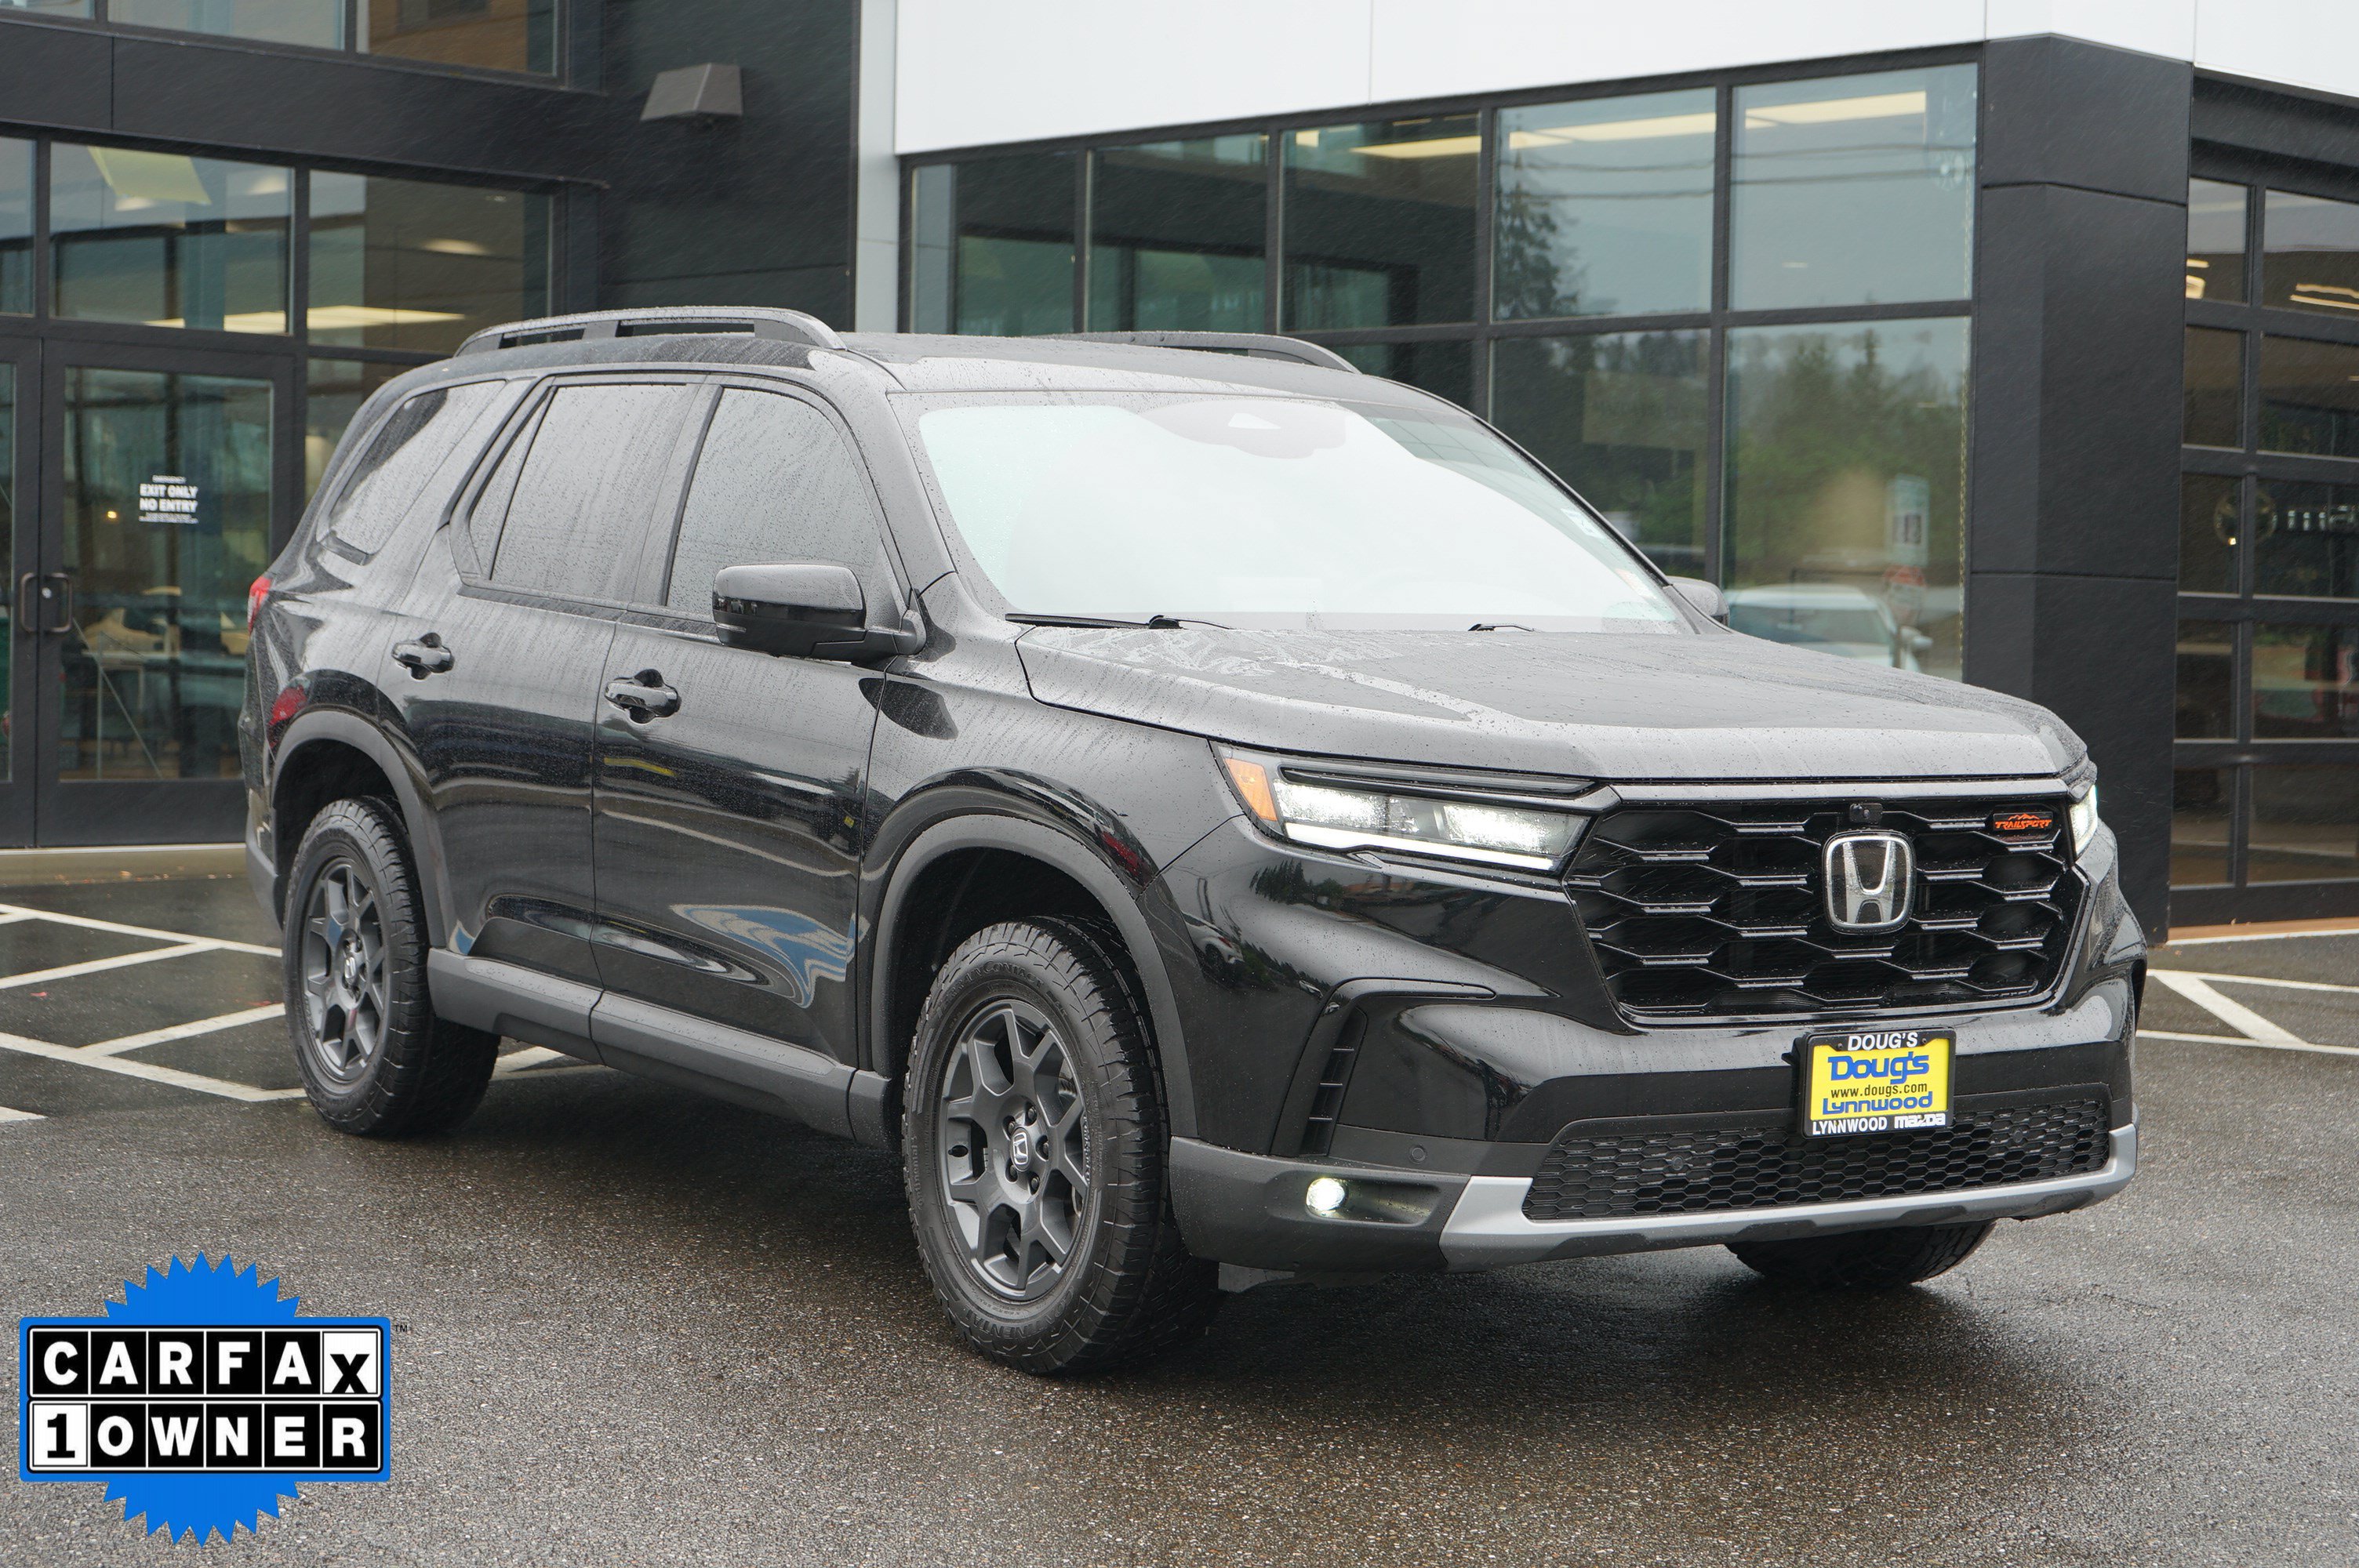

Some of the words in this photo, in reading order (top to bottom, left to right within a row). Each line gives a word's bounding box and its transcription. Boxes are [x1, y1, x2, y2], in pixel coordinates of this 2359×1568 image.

[140, 483, 167, 497] EXIT
[167, 485, 198, 499] ONLY
[140, 497, 158, 511] NO
[158, 499, 198, 513] ENTRY
[1995, 819, 2052, 829] TRAILSPORT
[1847, 1032, 1918, 1051] DOUG'S
[1827, 1051, 1930, 1084] Doug's
[1830, 1083, 1928, 1098] www.dougs.com
[1823, 1091, 1933, 1115] Lynnwood
[1812, 1116, 1888, 1135] LYNNWOOD
